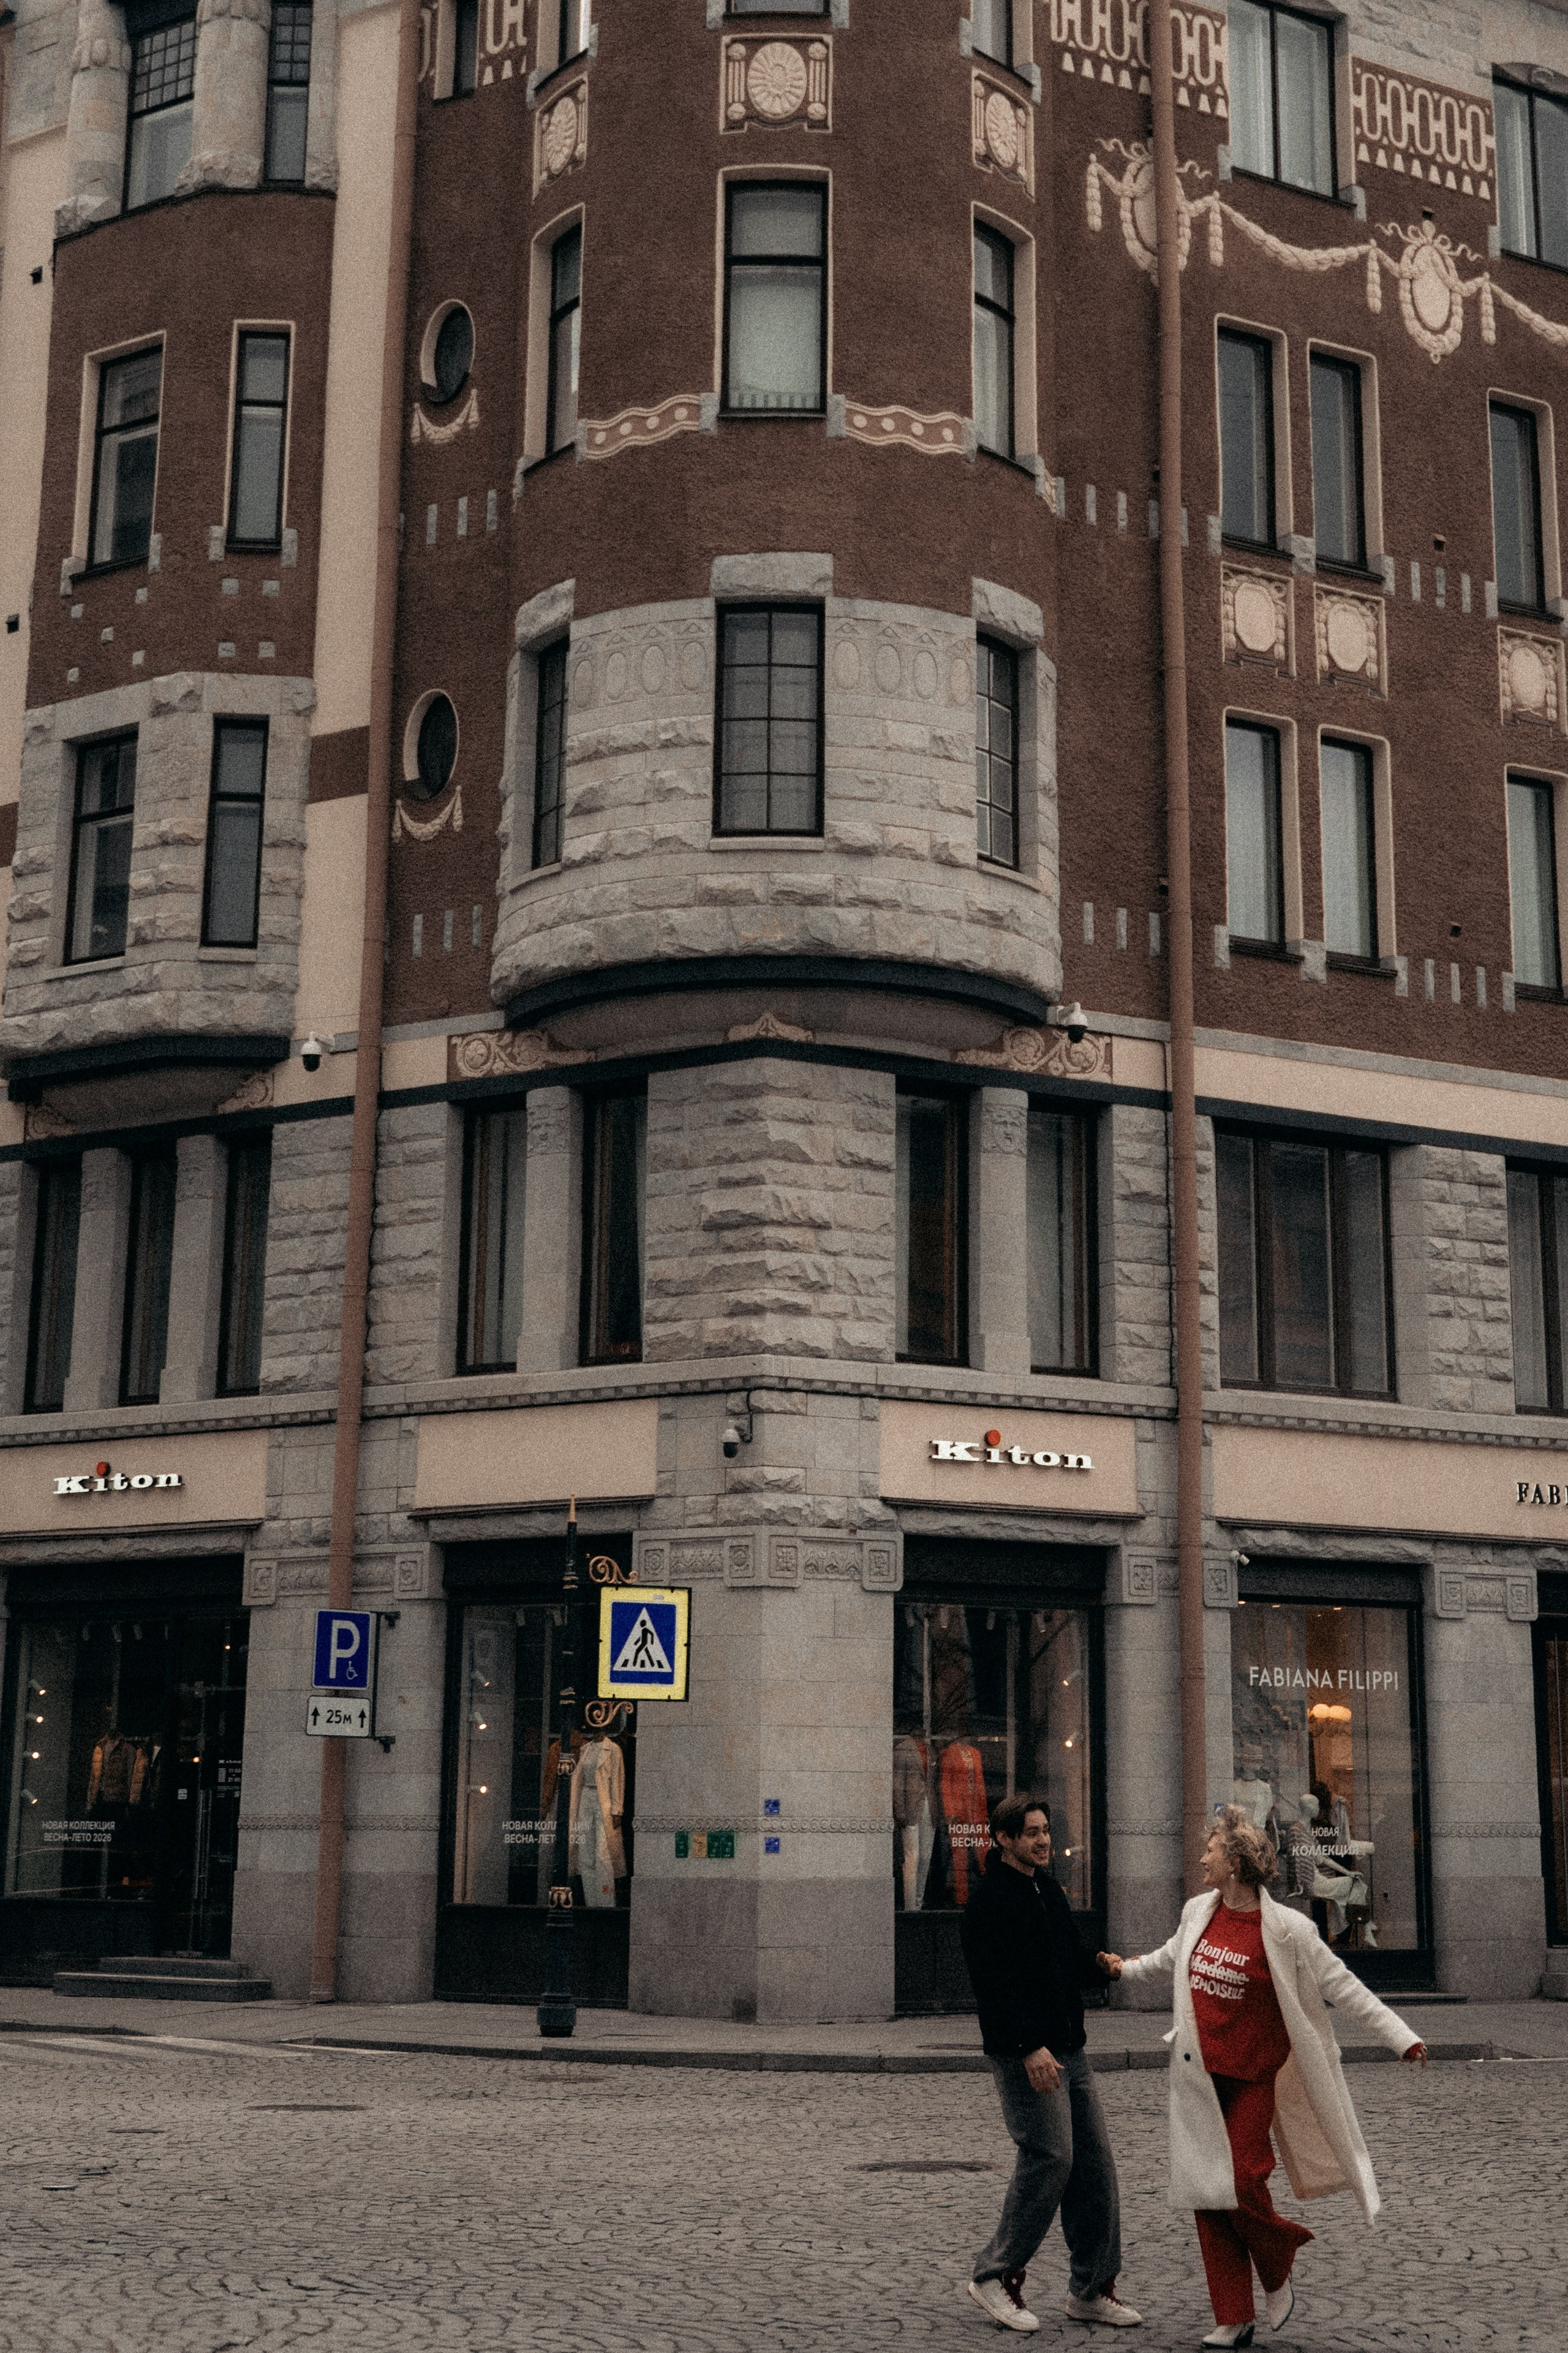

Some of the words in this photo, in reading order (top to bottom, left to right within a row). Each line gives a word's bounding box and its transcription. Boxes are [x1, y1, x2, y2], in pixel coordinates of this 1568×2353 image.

[930, 1429, 1095, 1469] Kiton
[53, 1461, 182, 1494] Kiton
[329, 1619, 360, 1679] P
[1249, 1666, 1333, 1689] FABIANA
[1338, 1669, 1398, 1691] FILIPPI
[42, 1821, 68, 1830] НОВАЯ
[69, 1821, 115, 1831] КОЛЛЕКЦИЯ
[502, 1821, 533, 1830] НОВАЯ
[949, 1824, 982, 1834] НОВАЯ
[44, 1832, 91, 1841] ВЕСНА-ЛЕТО
[93, 1833, 111, 1841] 2026
[1311, 1827, 1340, 1837] НОВАЯ
[505, 1834, 556, 1843] ВЕСНА-ЛЕТ
[569, 1834, 586, 1844] 026
[1292, 1845, 1360, 1857] КОЛЛЕКЦИЯ
[1195, 1938, 1250, 1966] Bonjour
